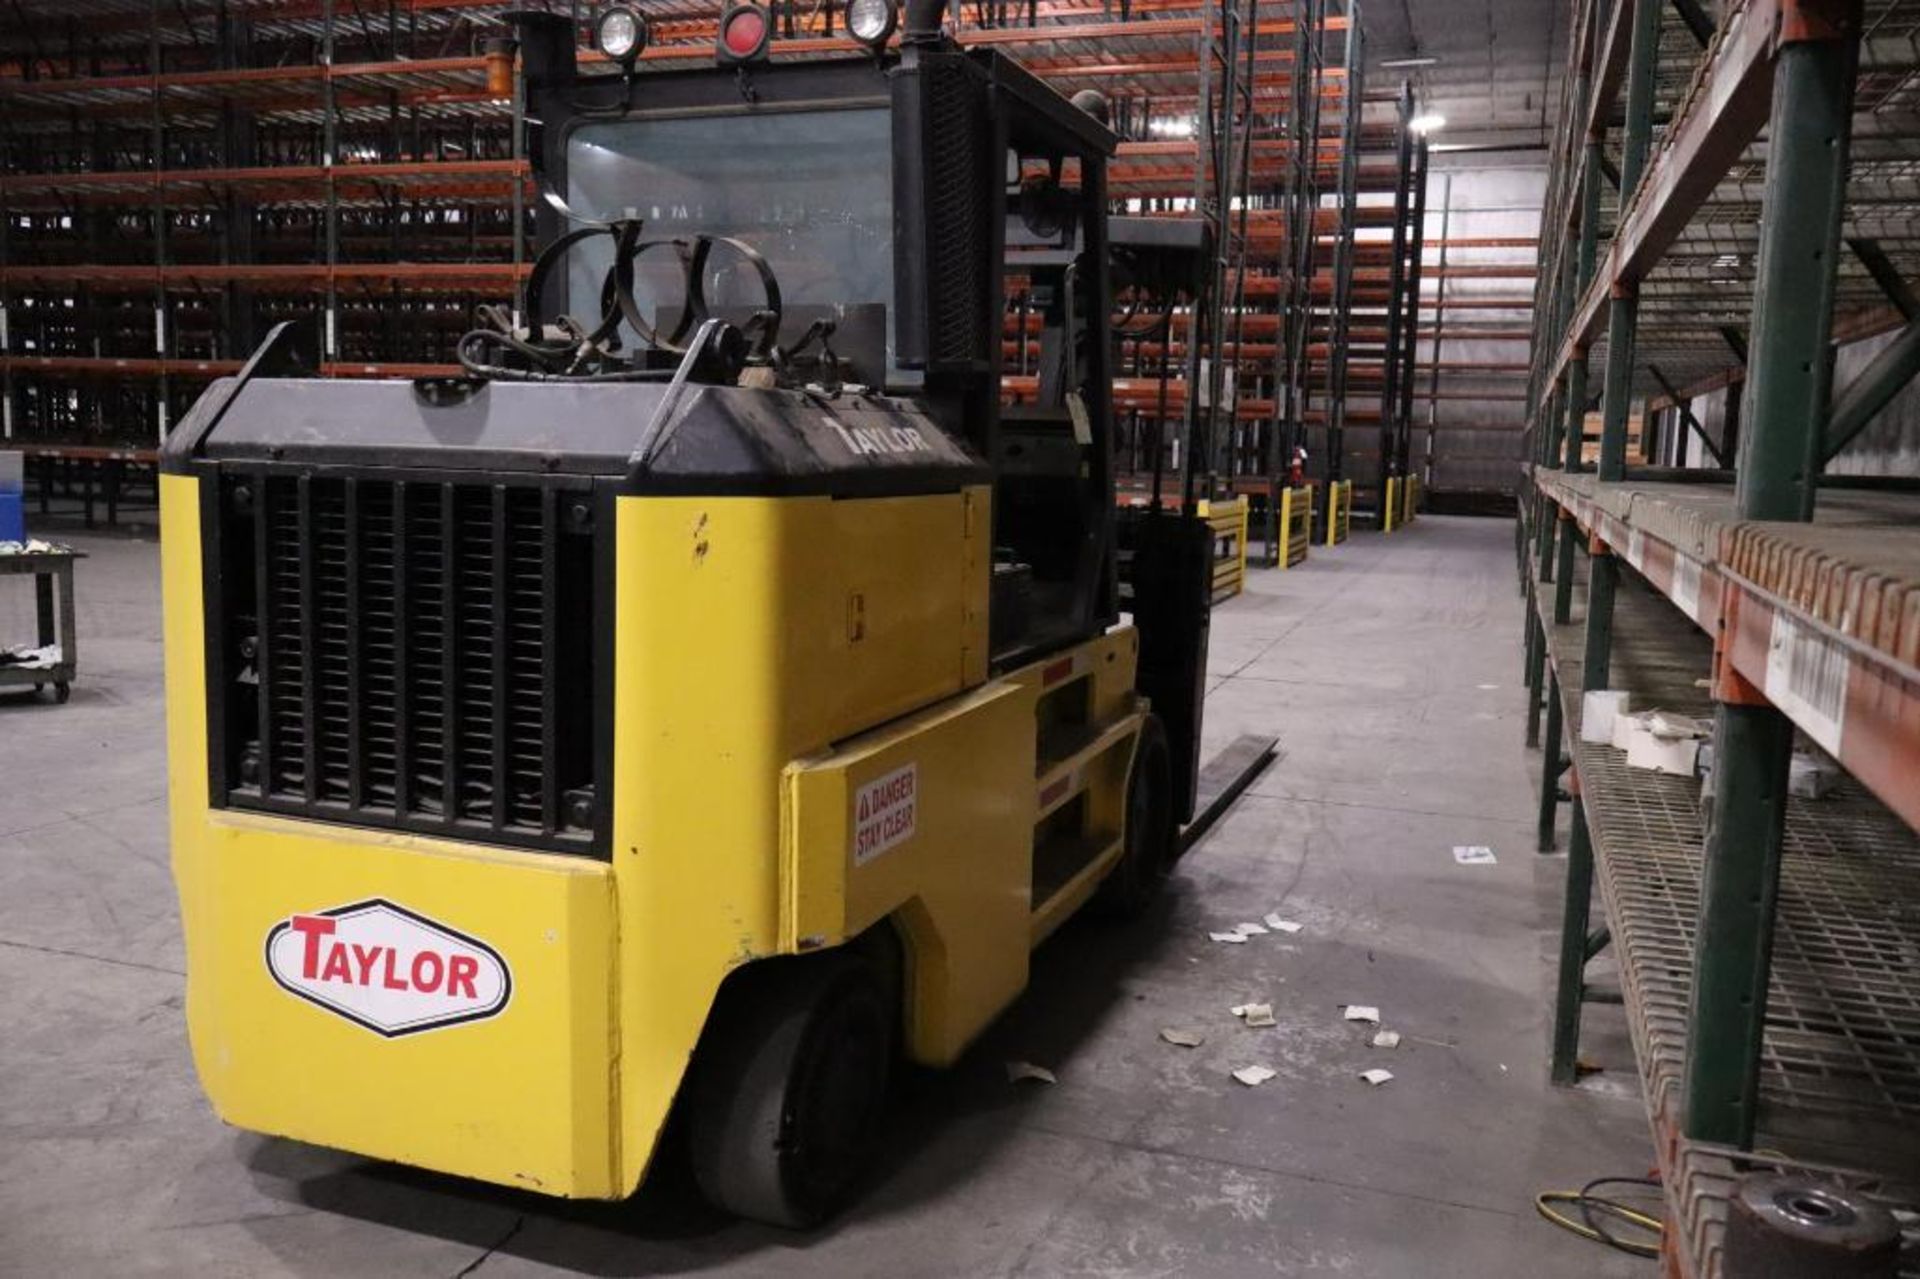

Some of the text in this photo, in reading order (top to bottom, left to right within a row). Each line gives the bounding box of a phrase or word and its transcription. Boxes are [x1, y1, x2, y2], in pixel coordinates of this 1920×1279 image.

[822, 416, 932, 455] TAYLOR
[872, 770, 914, 815] DANGER
[857, 803, 914, 857] STAY CLEAR
[292, 915, 480, 999] TAYLOR
